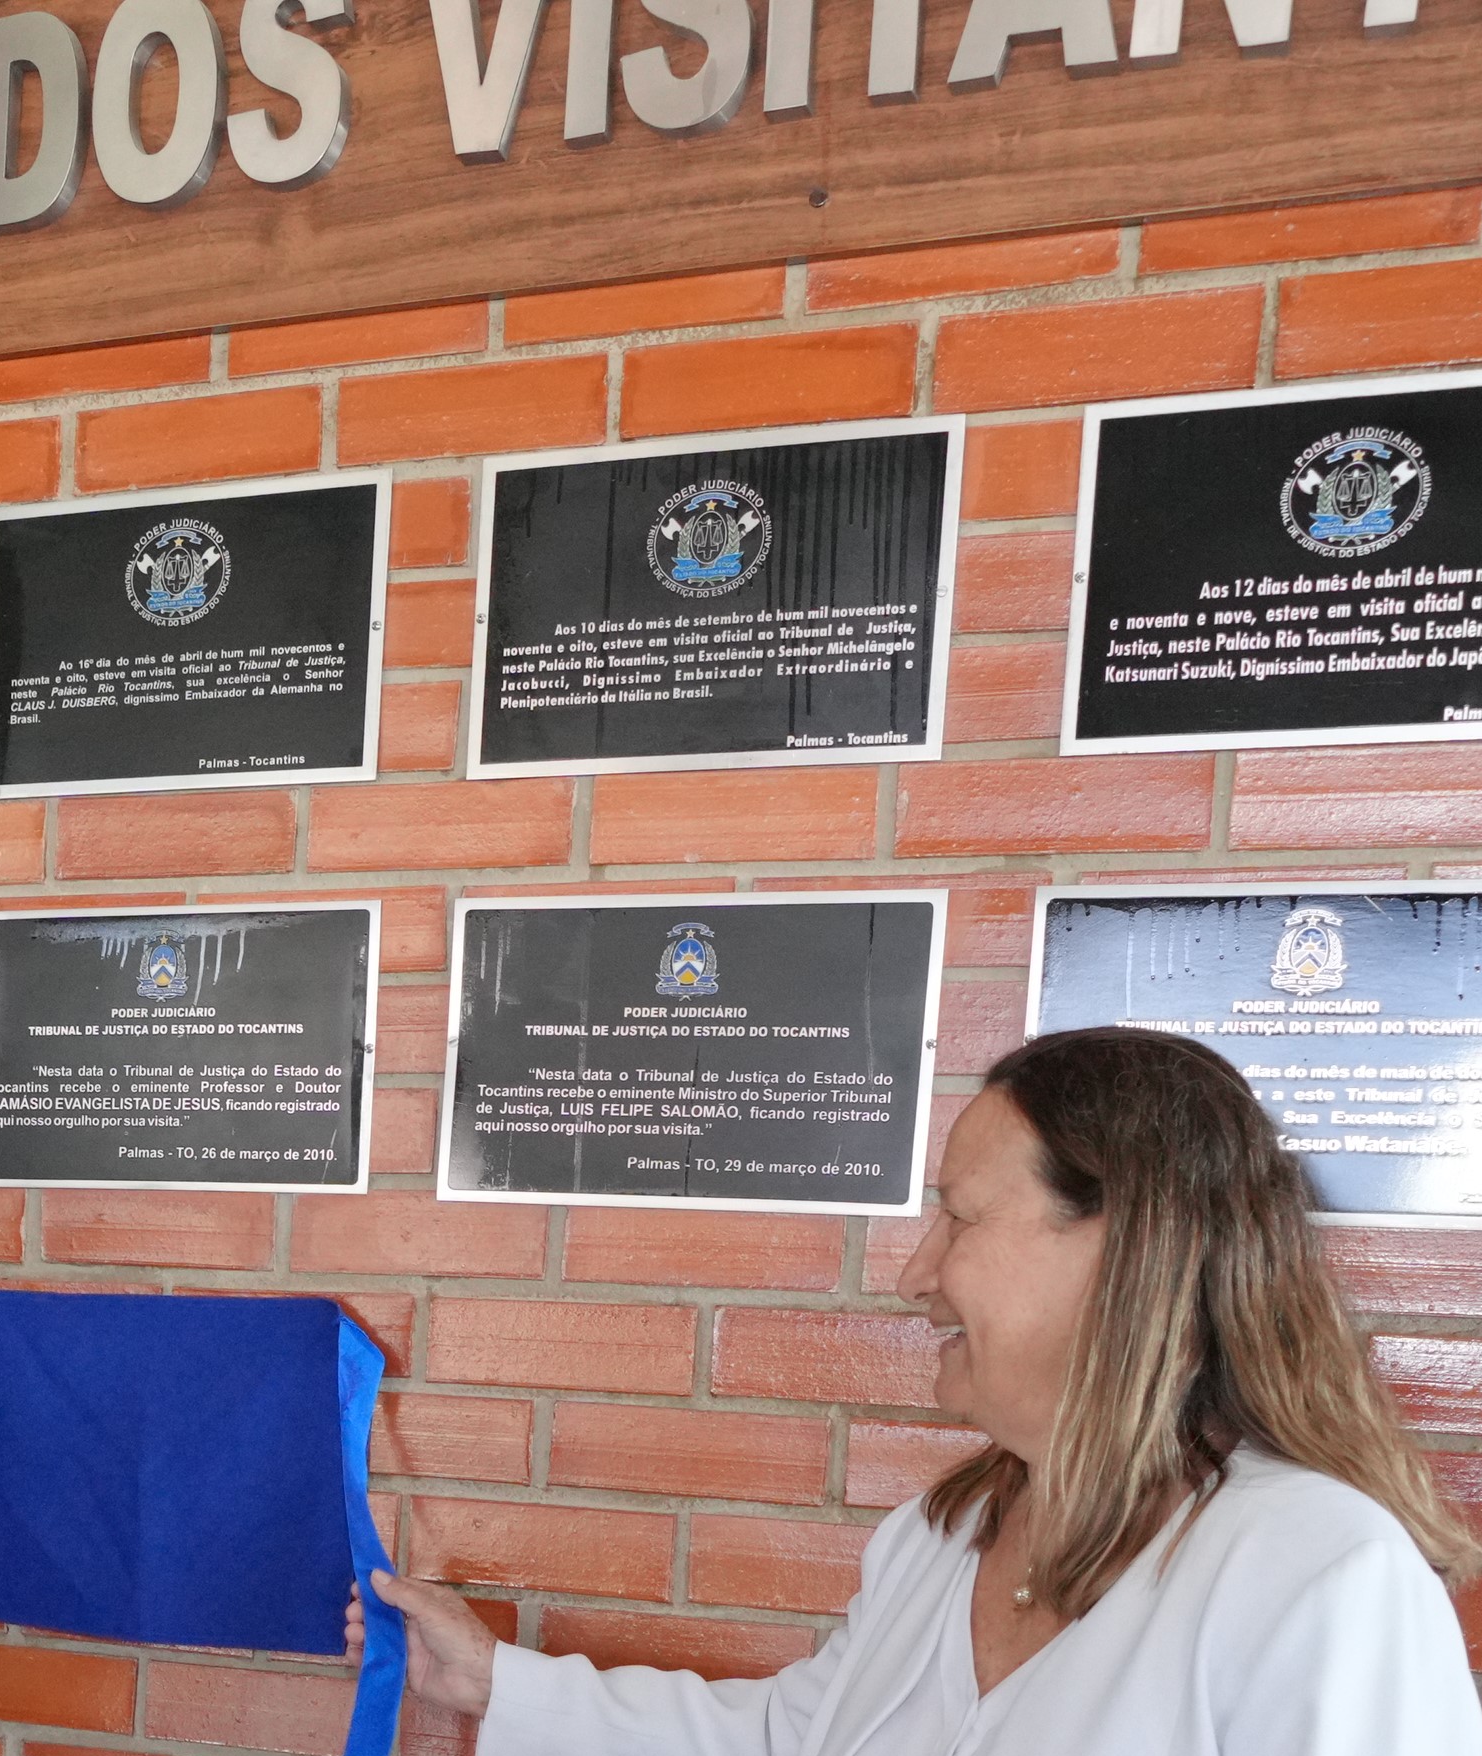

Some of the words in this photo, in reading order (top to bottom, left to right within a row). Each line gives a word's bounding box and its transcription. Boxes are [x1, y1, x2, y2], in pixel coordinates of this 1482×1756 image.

[1294, 431, 1342, 467] PODER
[1345, 426, 1423, 459] JUDICIÁRIO
[501, 675, 569, 691] Jacobucci,
[675, 664, 762, 681] Embaixador
[776, 657, 890, 675] Extraordinário
[905, 659, 913, 669] e
[1105, 662, 1178, 682] Katsunari
[1181, 658, 1236, 680] Suzuki,
[1328, 648, 1424, 672] Embaixador
[1426, 646, 1446, 667] do
[10, 700, 45, 712] CLAUS
[47, 699, 55, 709] J.
[61, 695, 118, 708] DUISBERG,
[185, 687, 246, 700] Embaixador
[251, 686, 264, 696] da
[270, 682, 322, 694] Alemanha
[329, 683, 342, 691] no
[10, 713, 40, 724] Brasil.
[1232, 1000, 1285, 1012] PODER
[1288, 998, 1379, 1013] JUDICIÁRIO
[55, 1097, 150, 1110] EVANGELISTA
[152, 1097, 171, 1110] DE
[173, 1097, 223, 1111] JESUS,
[225, 1098, 272, 1110] ficando
[274, 1099, 339, 1114] registrado
[476, 1101, 492, 1113] de
[499, 1101, 552, 1117] Justiça,
[560, 1102, 593, 1115] LUIS
[601, 1103, 653, 1116] FELIPE
[660, 1104, 741, 1120] SALOMÃO,
[750, 1106, 804, 1119] ficando
[813, 1108, 889, 1123] registrado
[627, 1156, 680, 1170] Palmas
[695, 1158, 719, 1172] TO,
[724, 1159, 741, 1171] 29
[746, 1160, 764, 1172] de
[769, 1163, 816, 1176] março
[821, 1162, 839, 1174] de
[844, 1162, 883, 1176] 2010.
